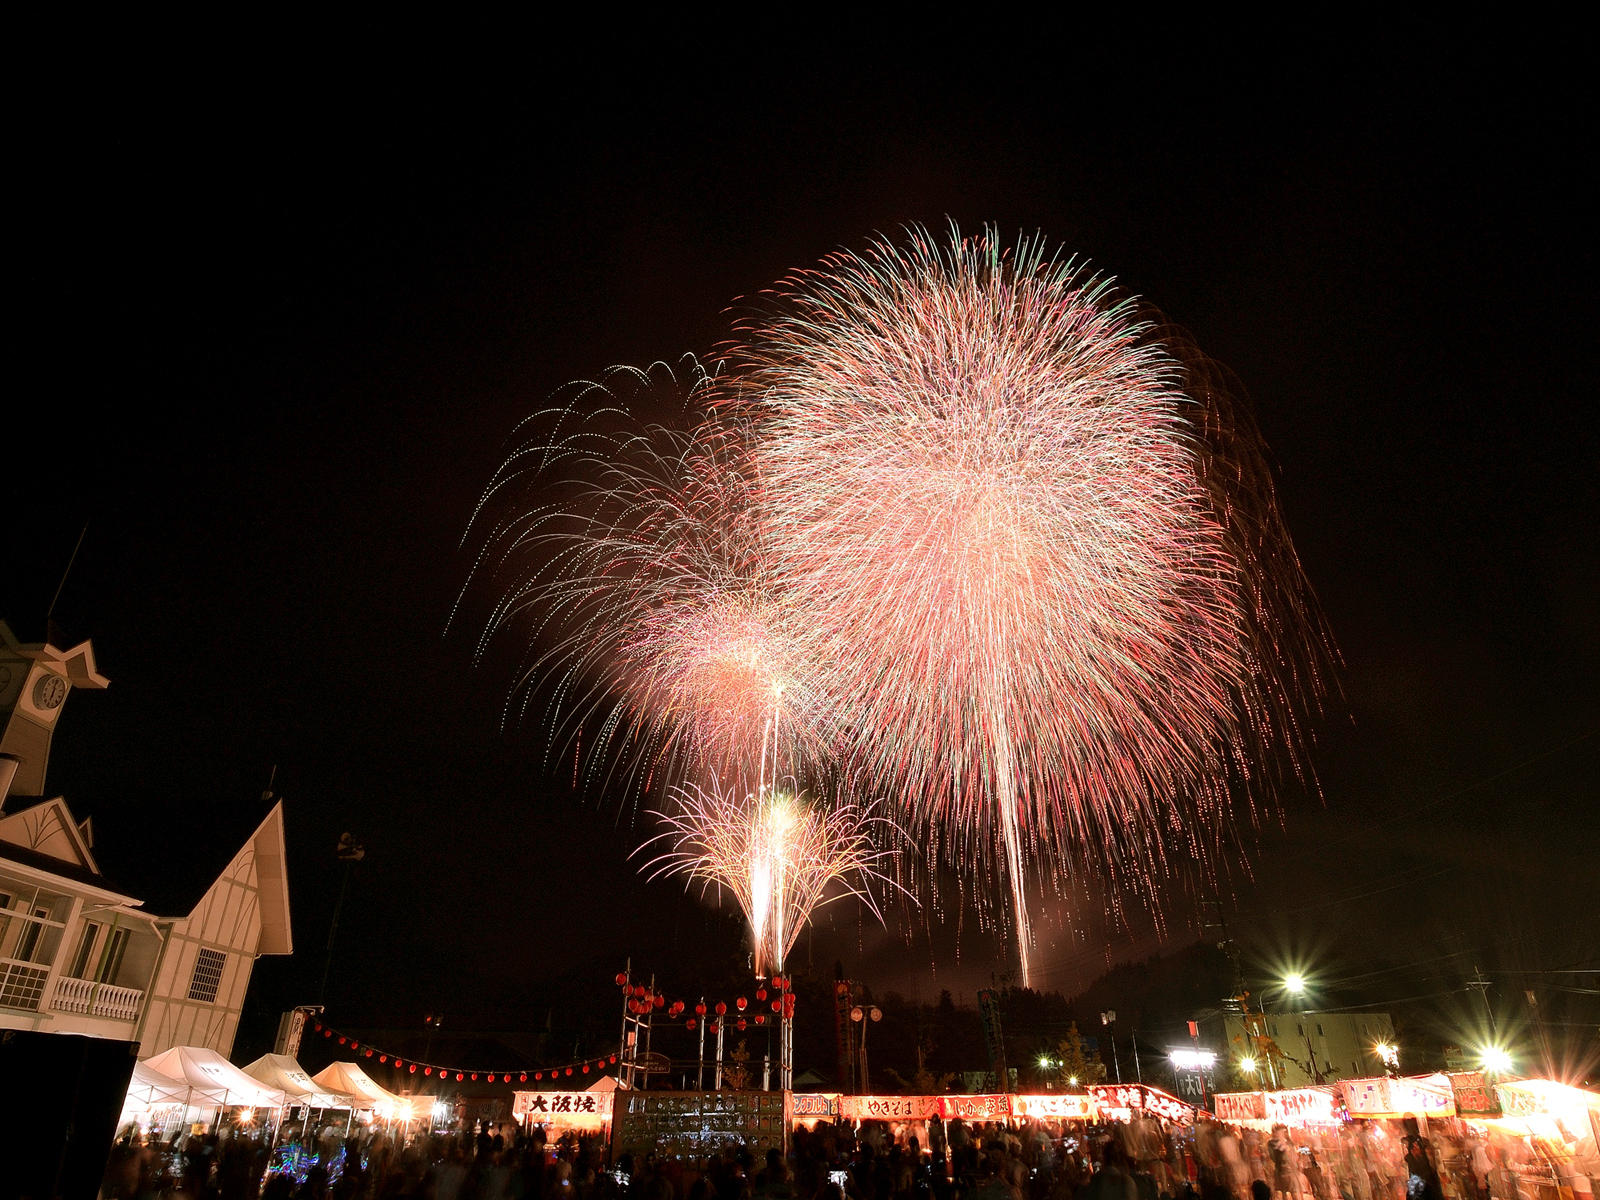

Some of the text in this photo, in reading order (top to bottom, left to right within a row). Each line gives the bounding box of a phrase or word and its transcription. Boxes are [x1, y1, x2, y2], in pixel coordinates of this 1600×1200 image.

[529, 1095, 596, 1112] 大阪焼
[792, 1098, 828, 1114] ンクフルト
[867, 1099, 913, 1116] やきそば
[1145, 1091, 1194, 1126] たこやき
